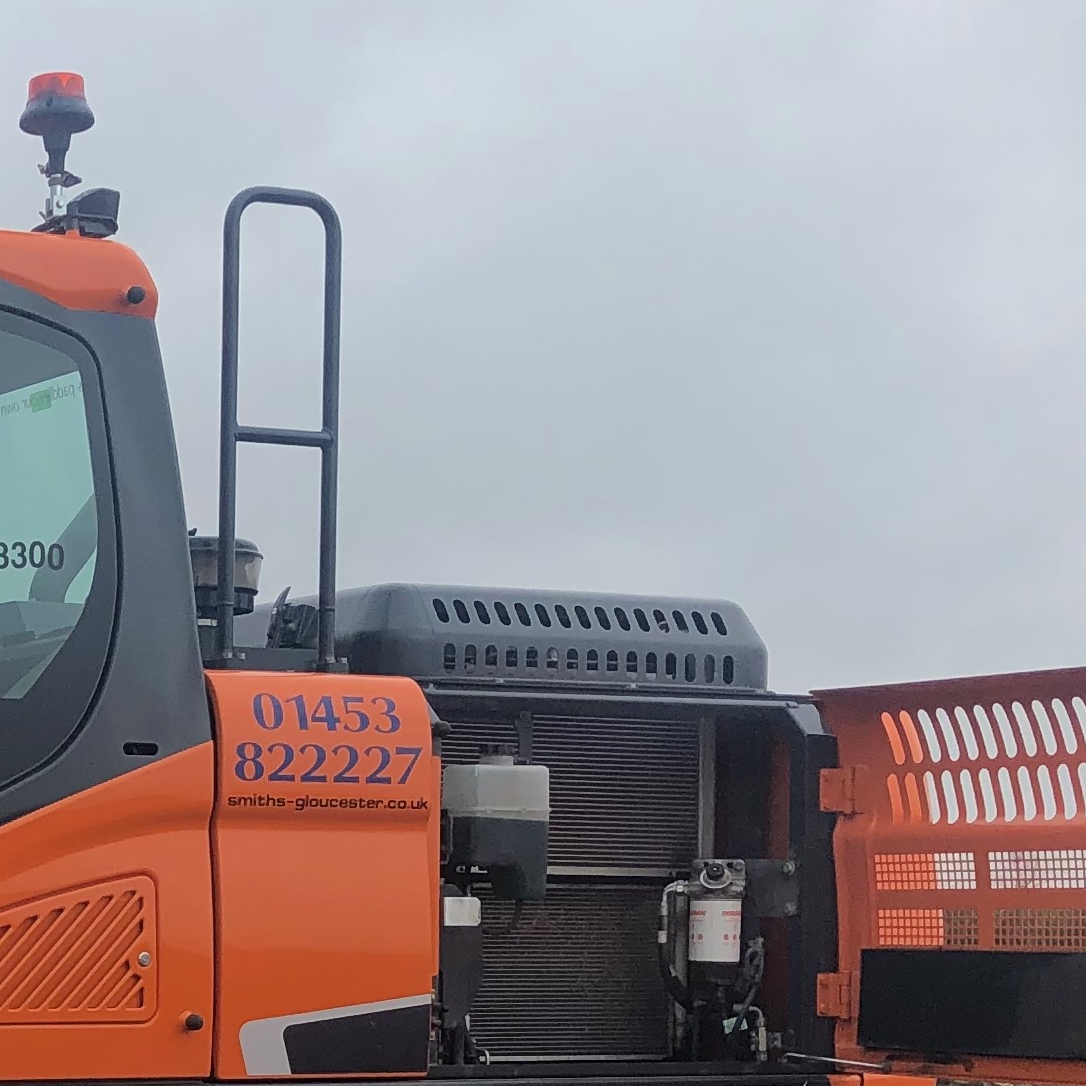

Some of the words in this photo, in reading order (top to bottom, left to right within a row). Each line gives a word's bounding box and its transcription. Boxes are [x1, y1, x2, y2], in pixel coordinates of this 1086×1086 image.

[252, 692, 401, 734] 01453
[234, 741, 423, 785] 822227
[227, 793, 428, 811] smiths-gloucester.co.uk
